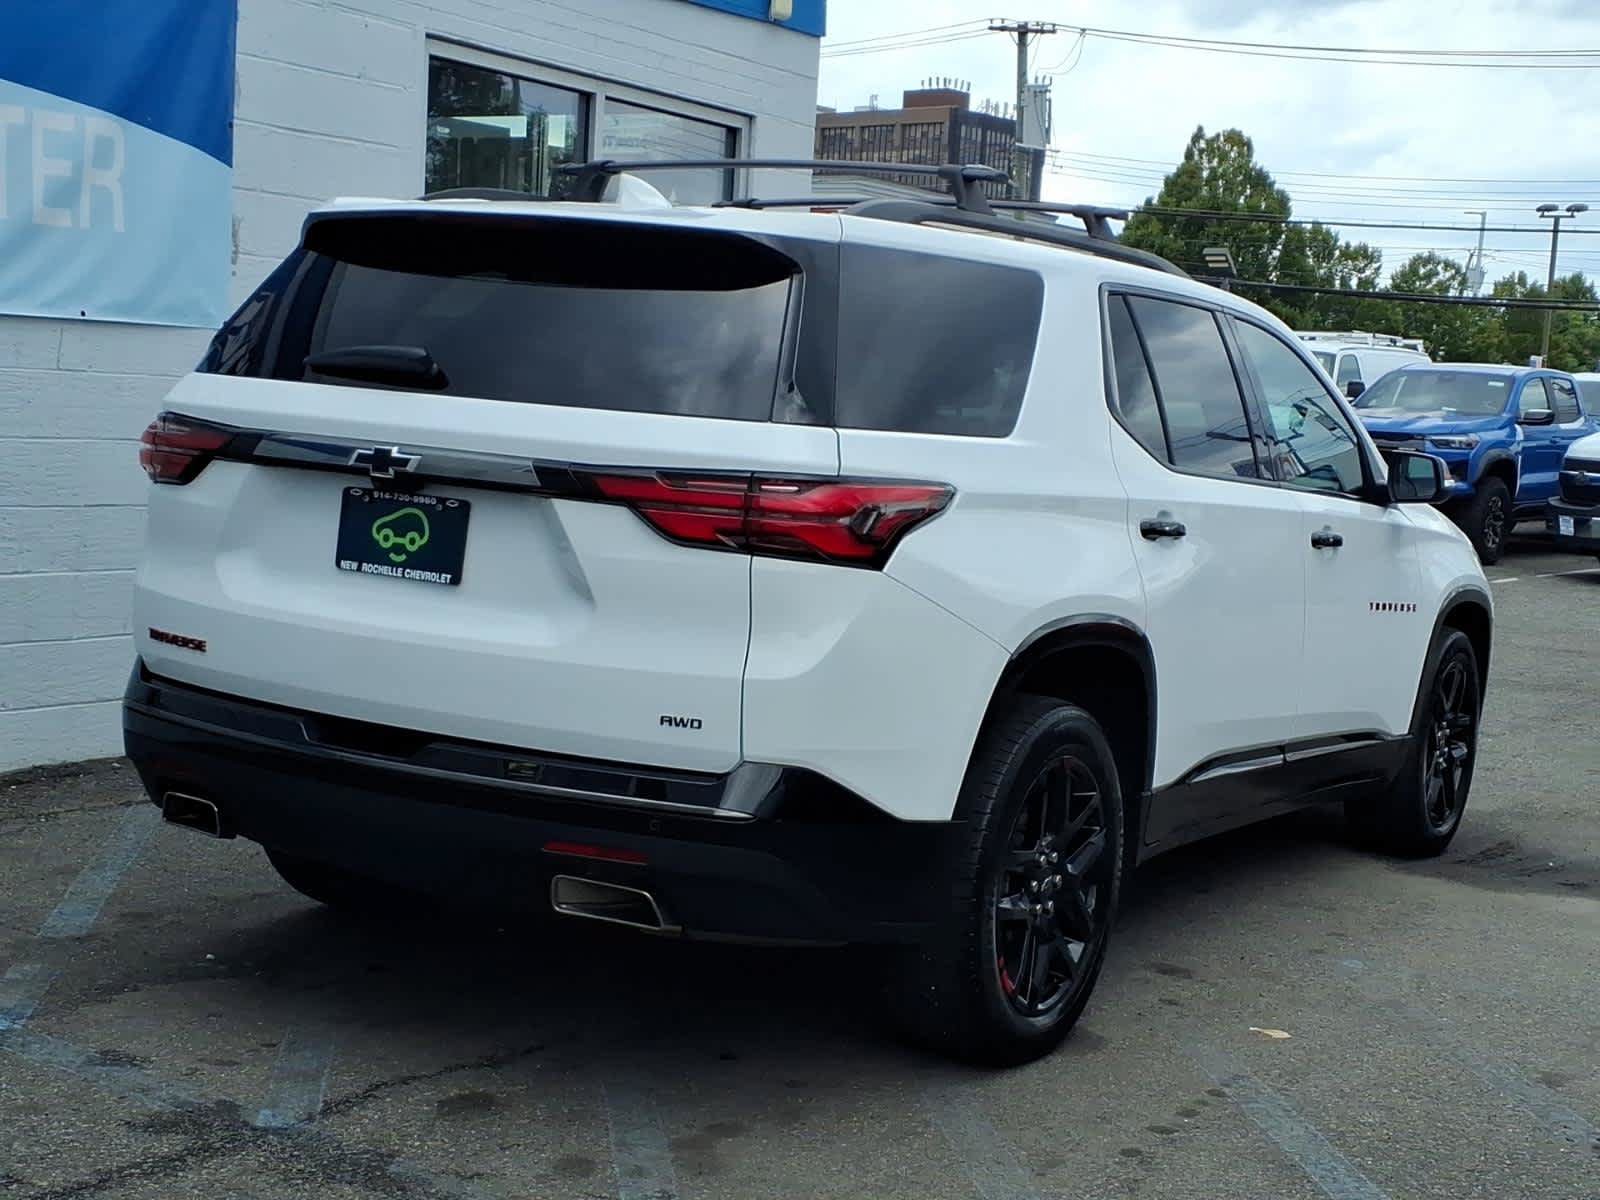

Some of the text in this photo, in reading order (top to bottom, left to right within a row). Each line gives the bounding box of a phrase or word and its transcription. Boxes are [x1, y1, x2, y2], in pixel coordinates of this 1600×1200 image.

[340, 559, 452, 584] NEW ROCHELLE CHEVROLET
[660, 715, 703, 730] AWD
